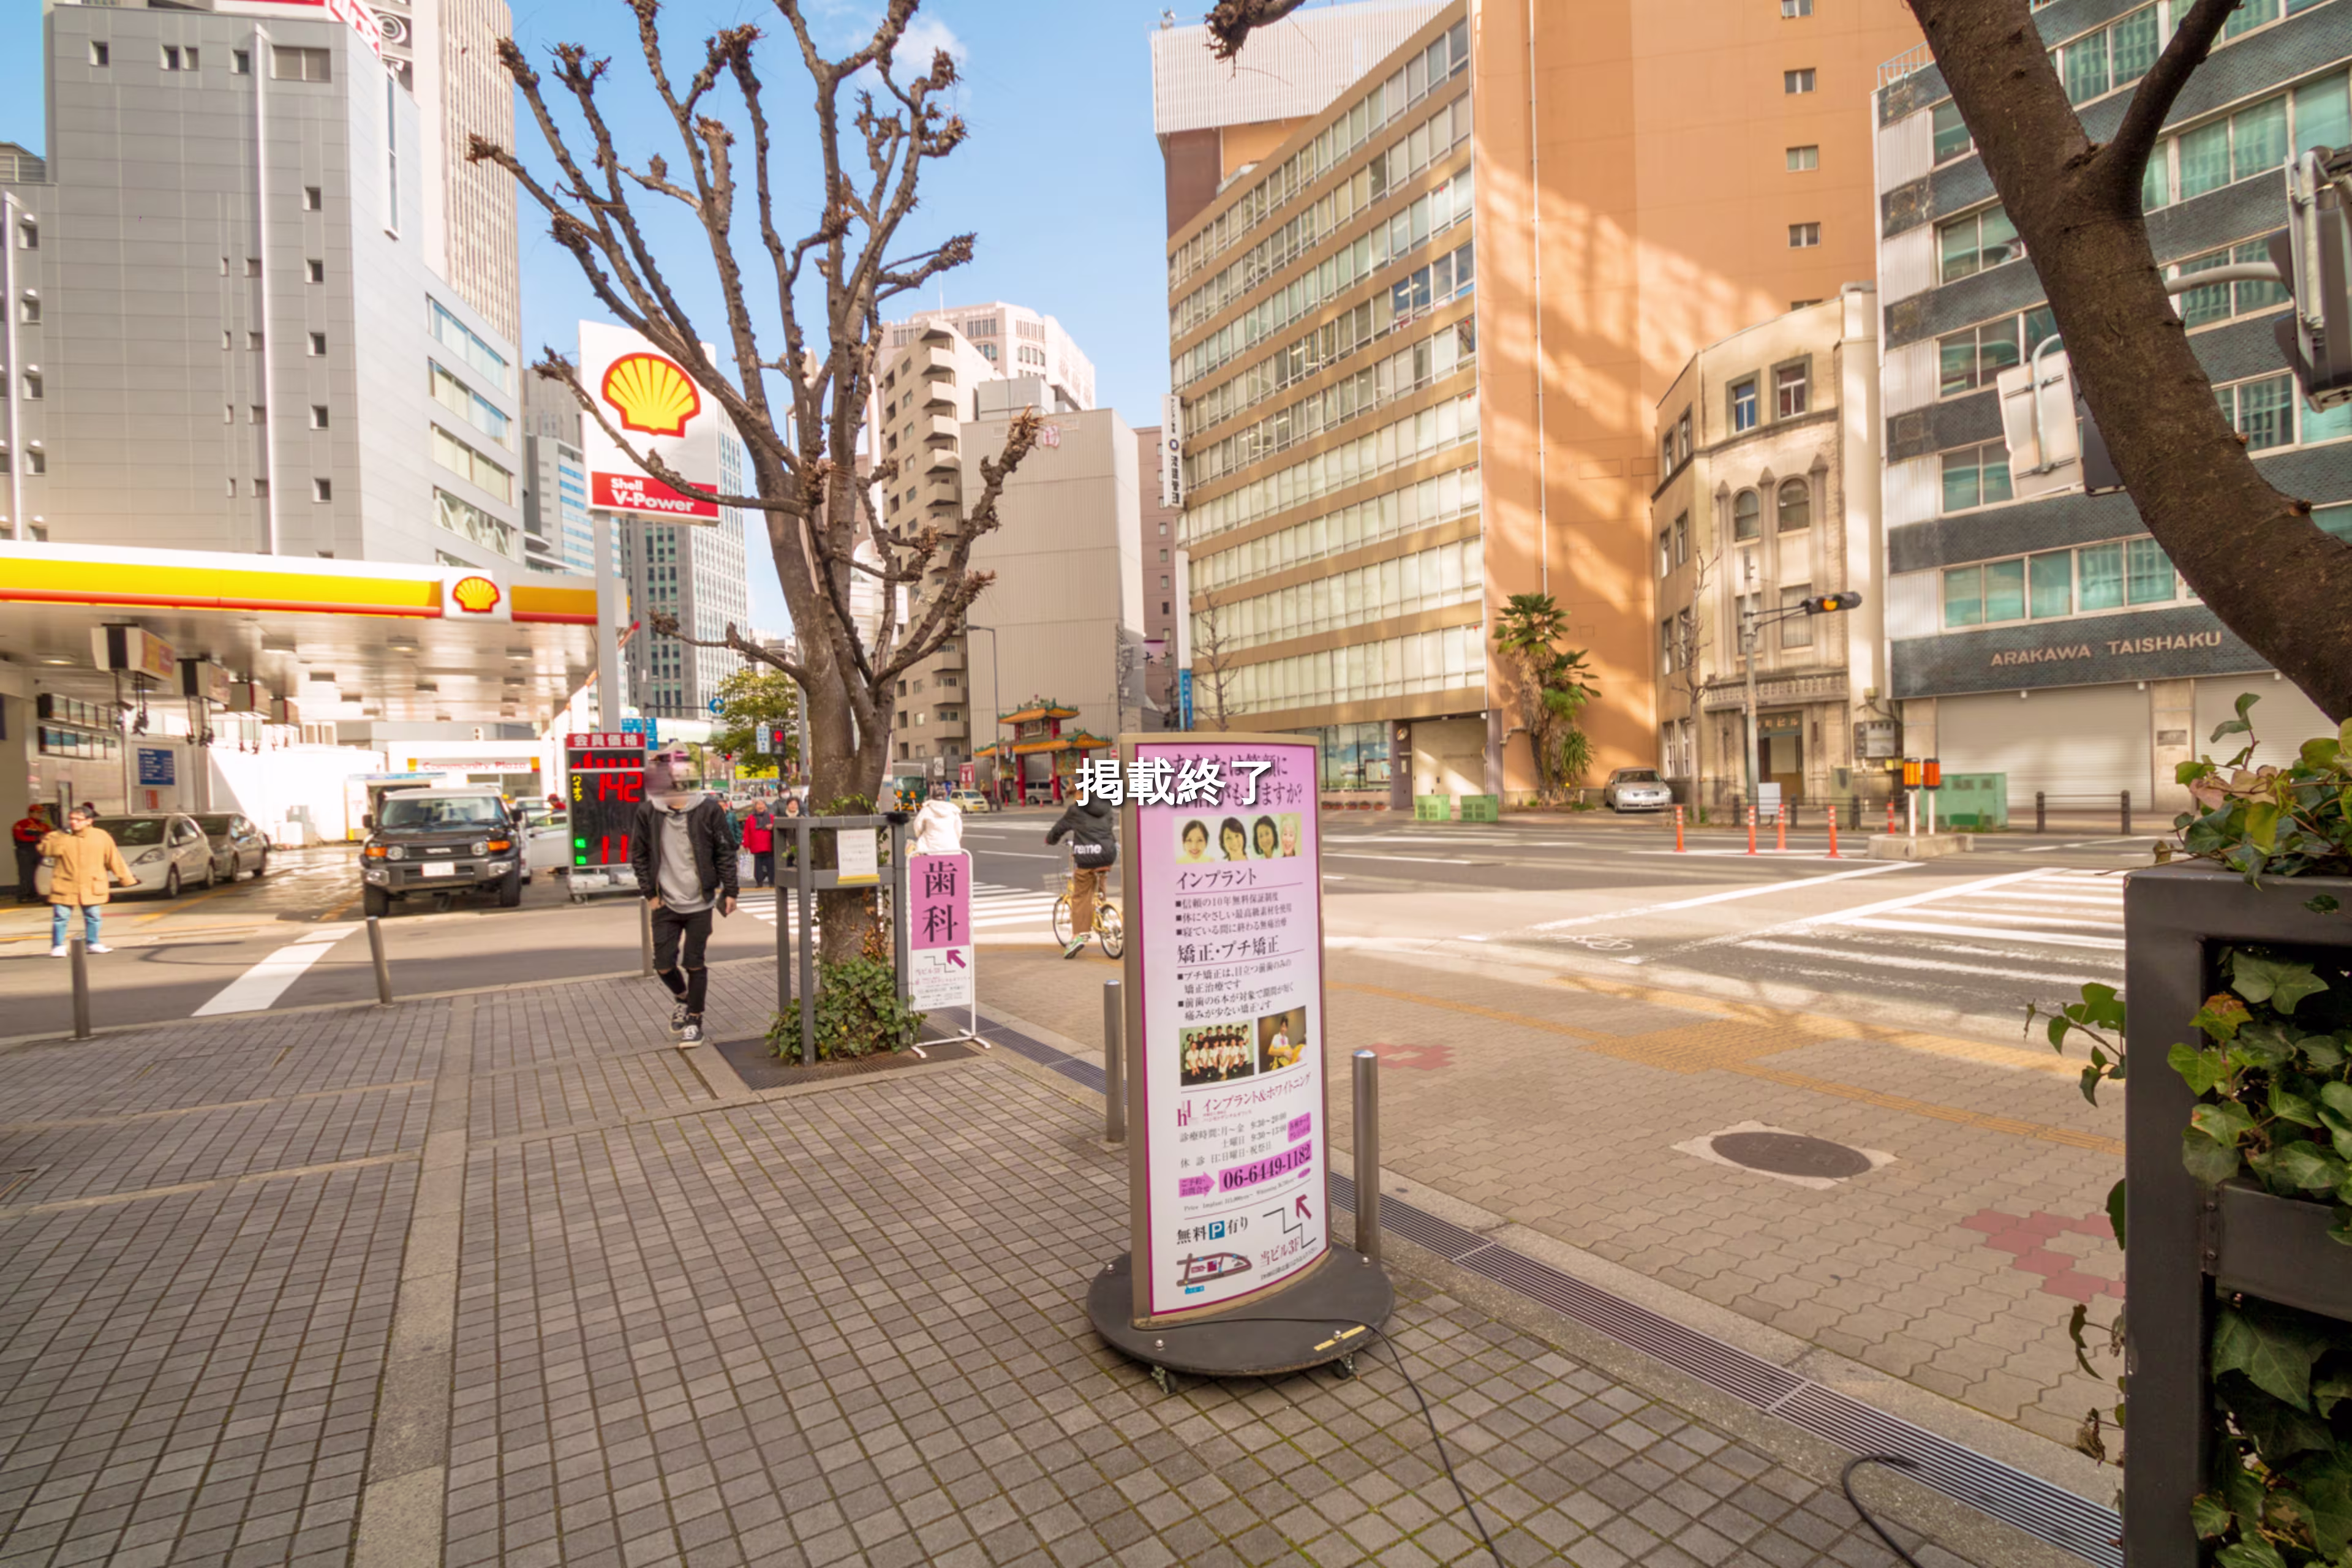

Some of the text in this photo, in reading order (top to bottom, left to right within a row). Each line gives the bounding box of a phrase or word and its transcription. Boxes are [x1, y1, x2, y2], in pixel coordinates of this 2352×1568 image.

[610, 477, 644, 491] Shell
[611, 489, 695, 513] V-Power
[1990, 630, 2222, 667] ARAKAWA TAISHAKU
[573, 734, 638, 747] 会員価格
[422, 760, 527, 771] Community Plaza
[598, 771, 643, 803] 142
[1176, 868, 1257, 890] インプラント
[922, 860, 959, 943] 歯科
[1223, 1143, 1311, 1190] 06-6449-1182
